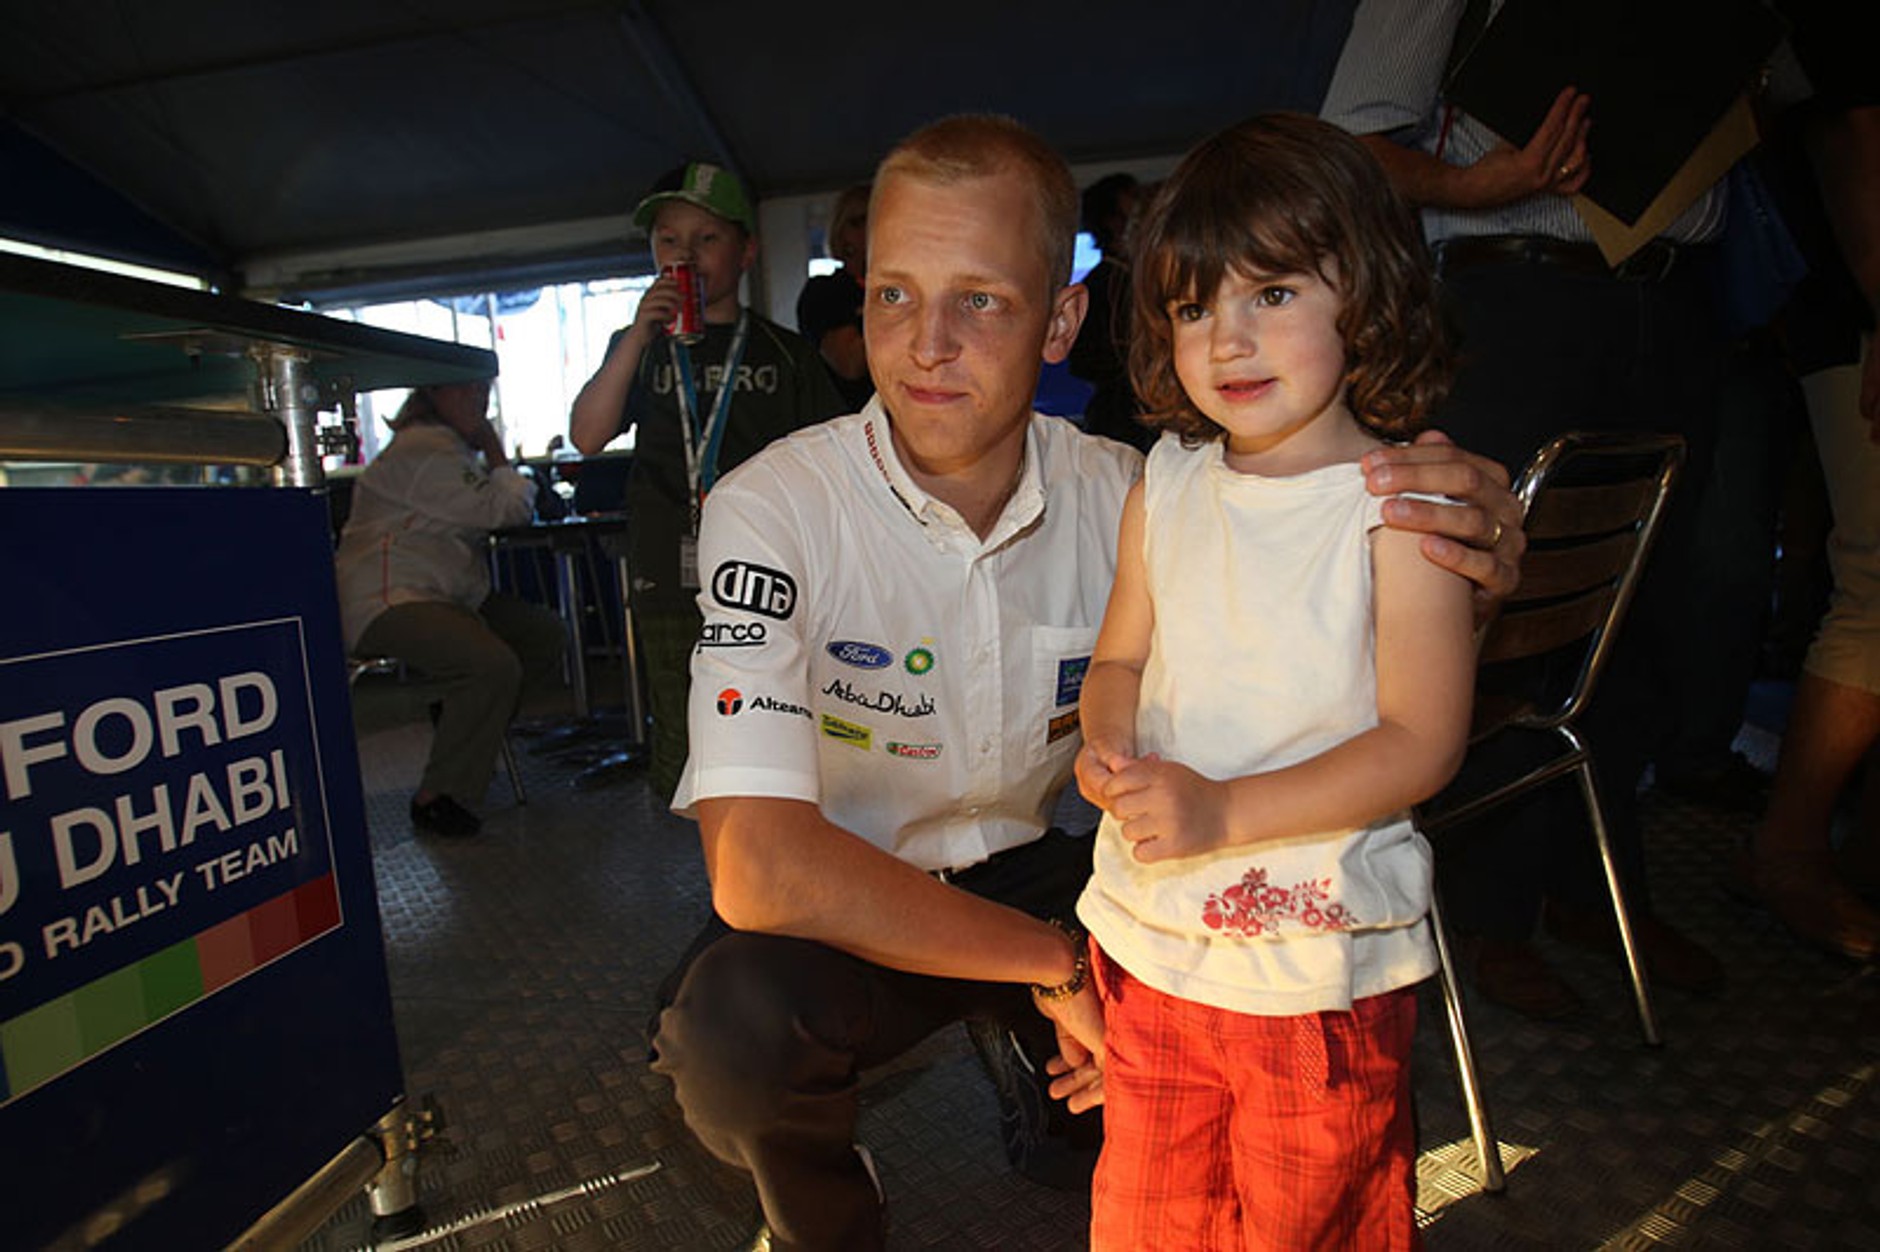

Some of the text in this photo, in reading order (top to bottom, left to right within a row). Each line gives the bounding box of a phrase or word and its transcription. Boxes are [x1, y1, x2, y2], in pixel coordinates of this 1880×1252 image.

[698, 622, 766, 646] arco
[1, 671, 279, 800] FORD
[51, 749, 291, 890] DHABI
[42, 873, 186, 960] RALLY
[196, 828, 299, 890] TEAM
